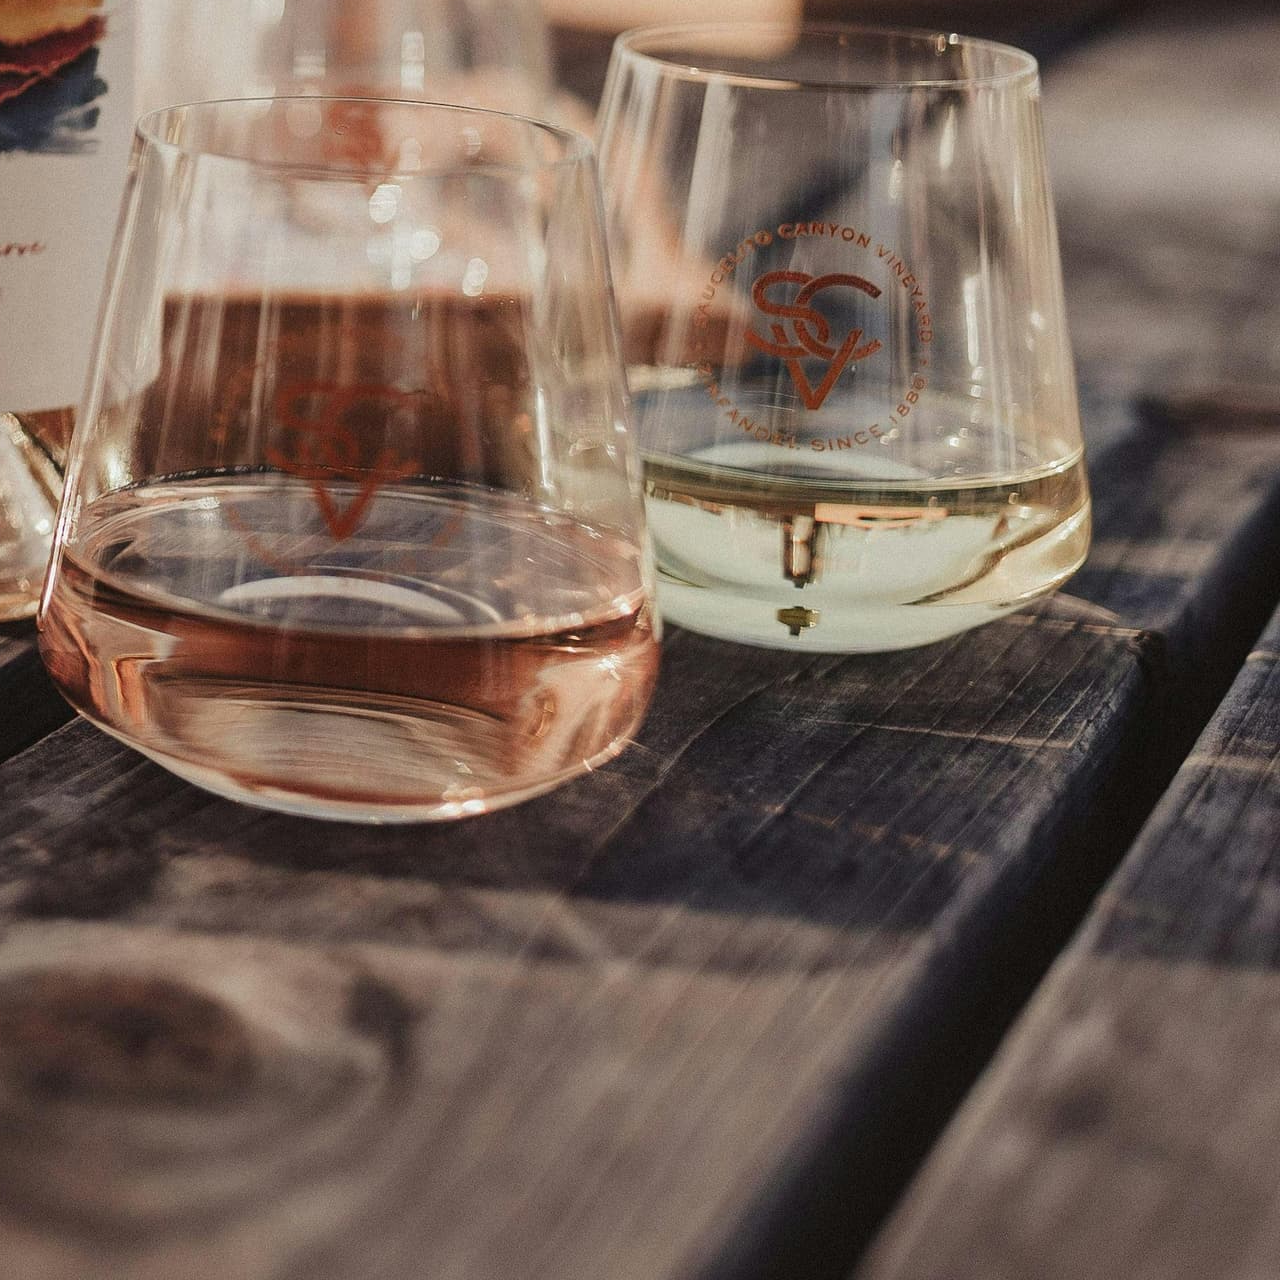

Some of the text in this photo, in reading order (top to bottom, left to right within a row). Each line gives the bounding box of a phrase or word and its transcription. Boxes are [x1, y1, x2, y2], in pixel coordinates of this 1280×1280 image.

[777, 221, 871, 249] CANYON
[876, 243, 933, 344] VINEYARD
[810, 423, 884, 452] SINCE
